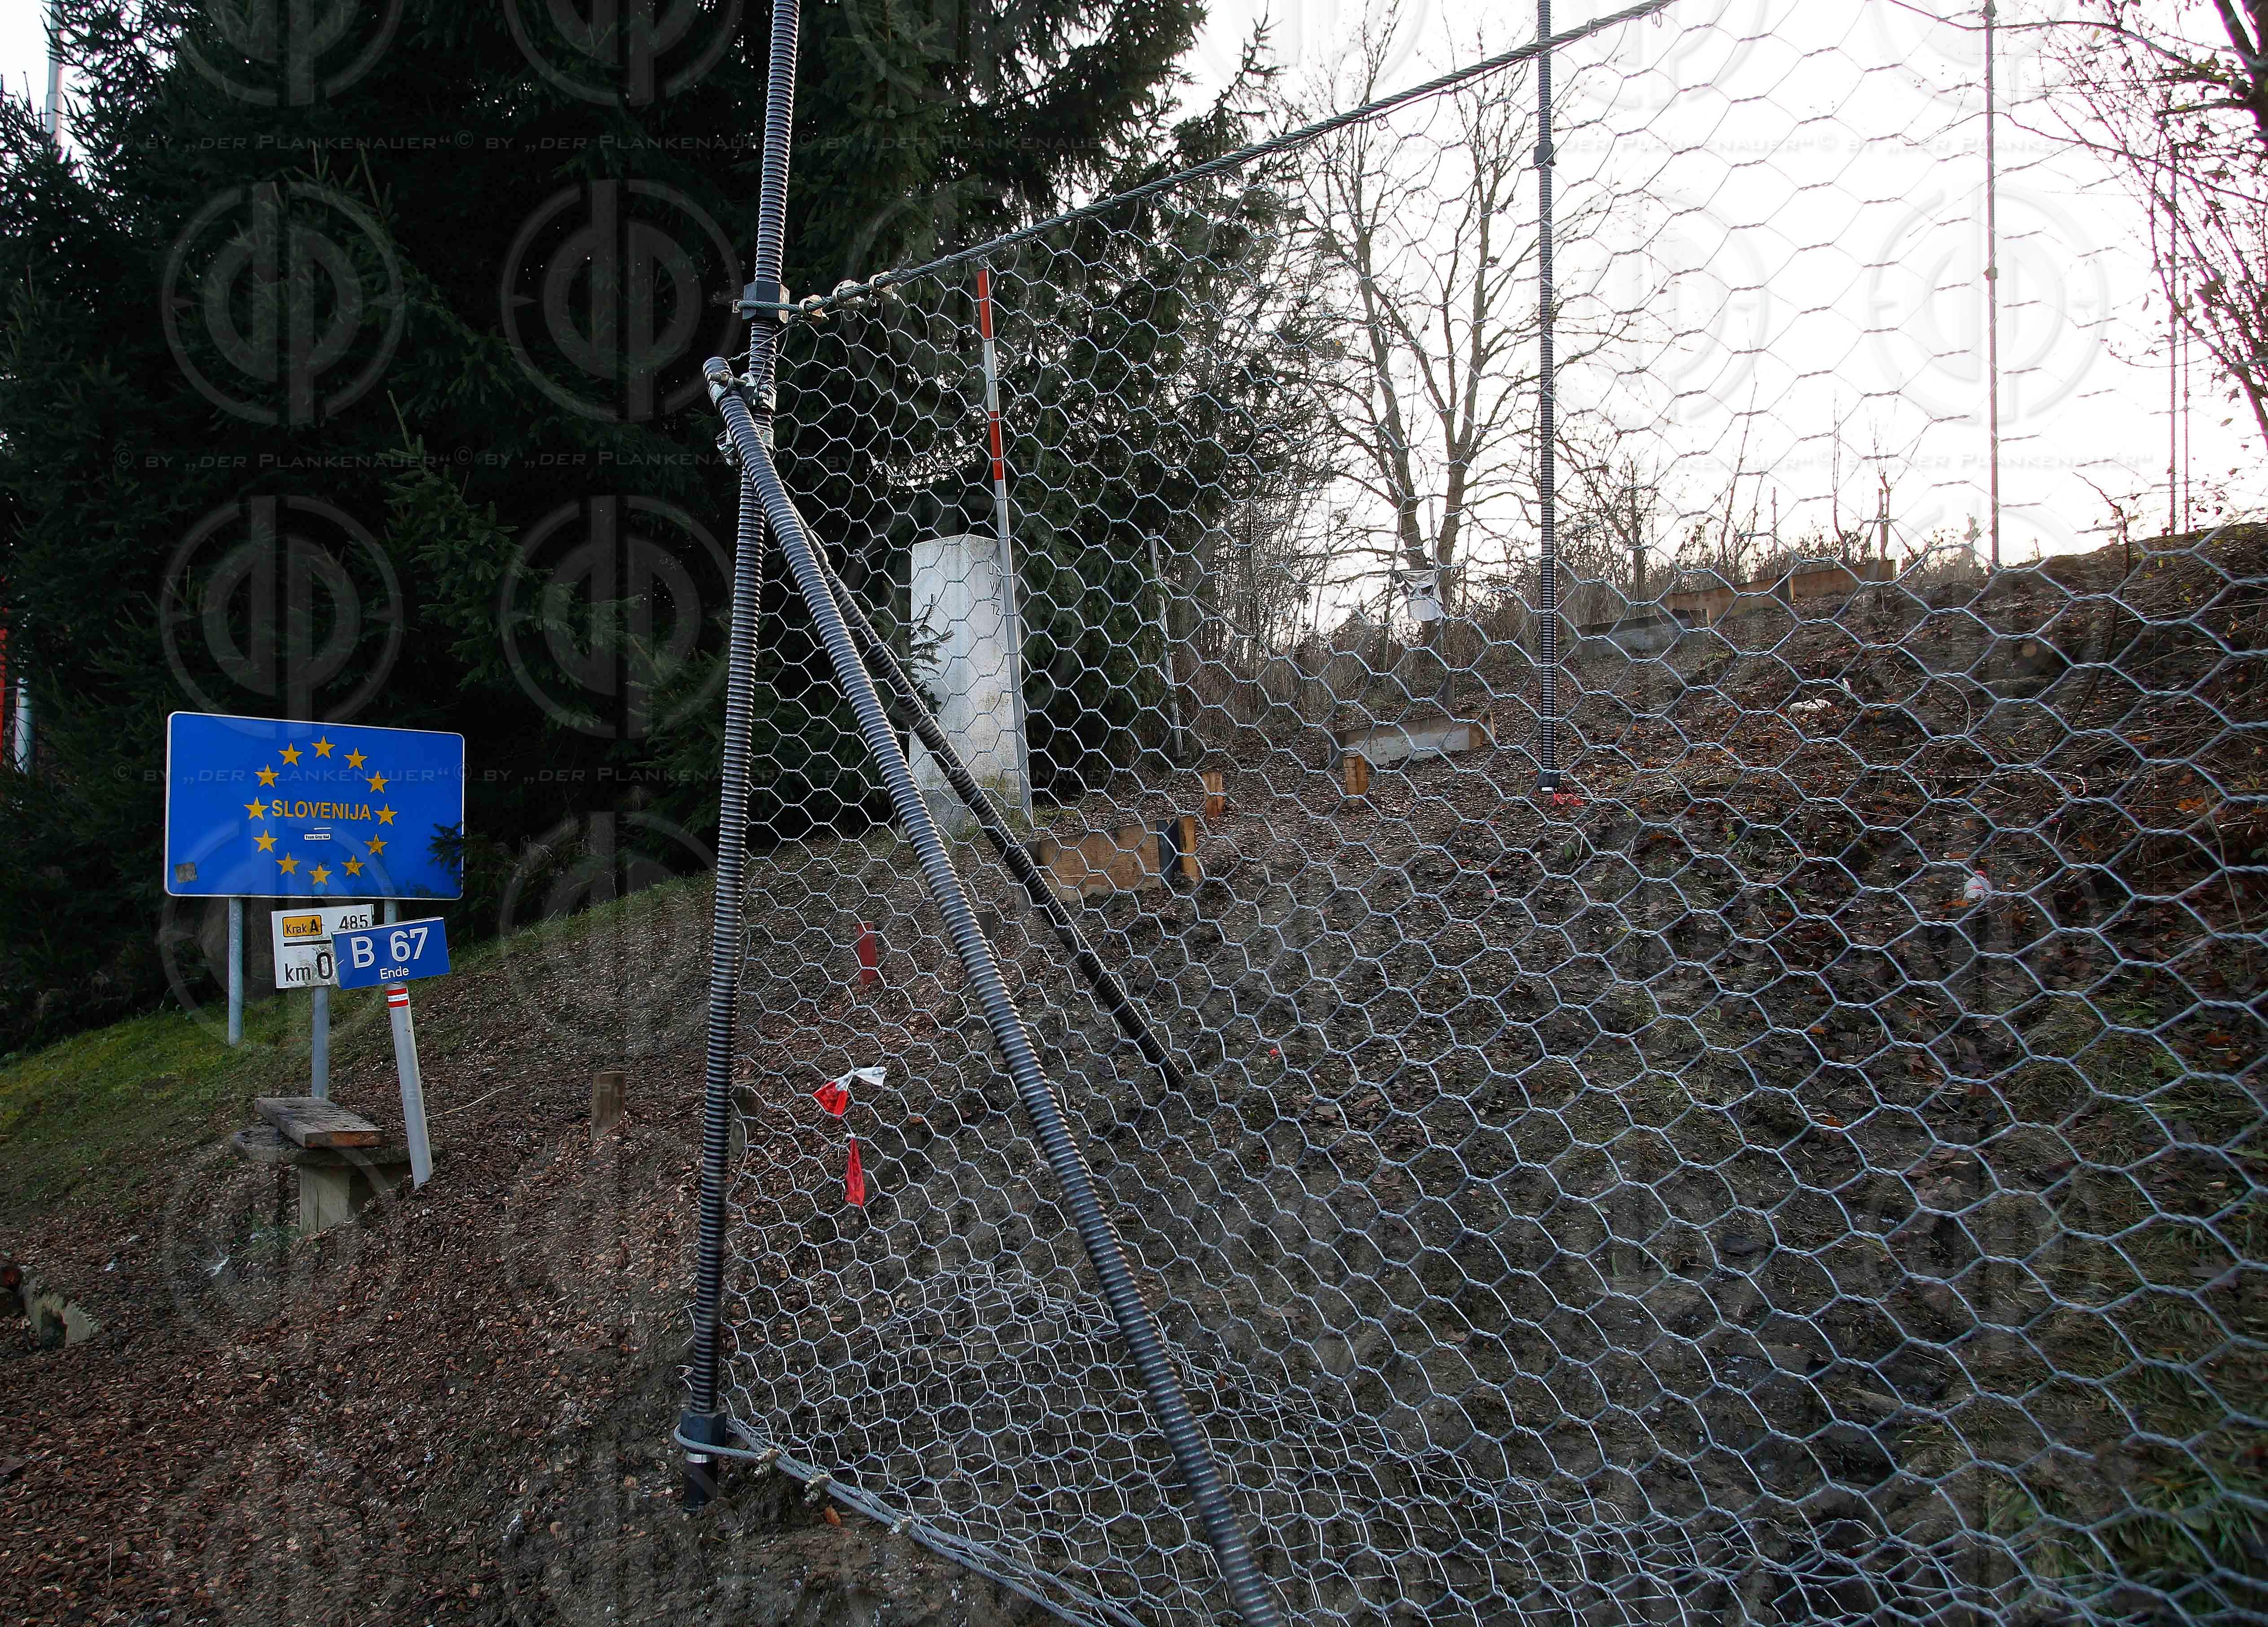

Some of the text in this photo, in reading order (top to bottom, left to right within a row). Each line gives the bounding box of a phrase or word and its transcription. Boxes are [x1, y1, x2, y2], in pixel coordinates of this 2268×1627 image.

[272, 799, 372, 821] SLOVENIJA
[310, 919, 320, 932] A
[338, 914, 368, 930] 485
[351, 927, 428, 969] B 67
[285, 952, 333, 982] km 0
[380, 966, 409, 980] Ende
